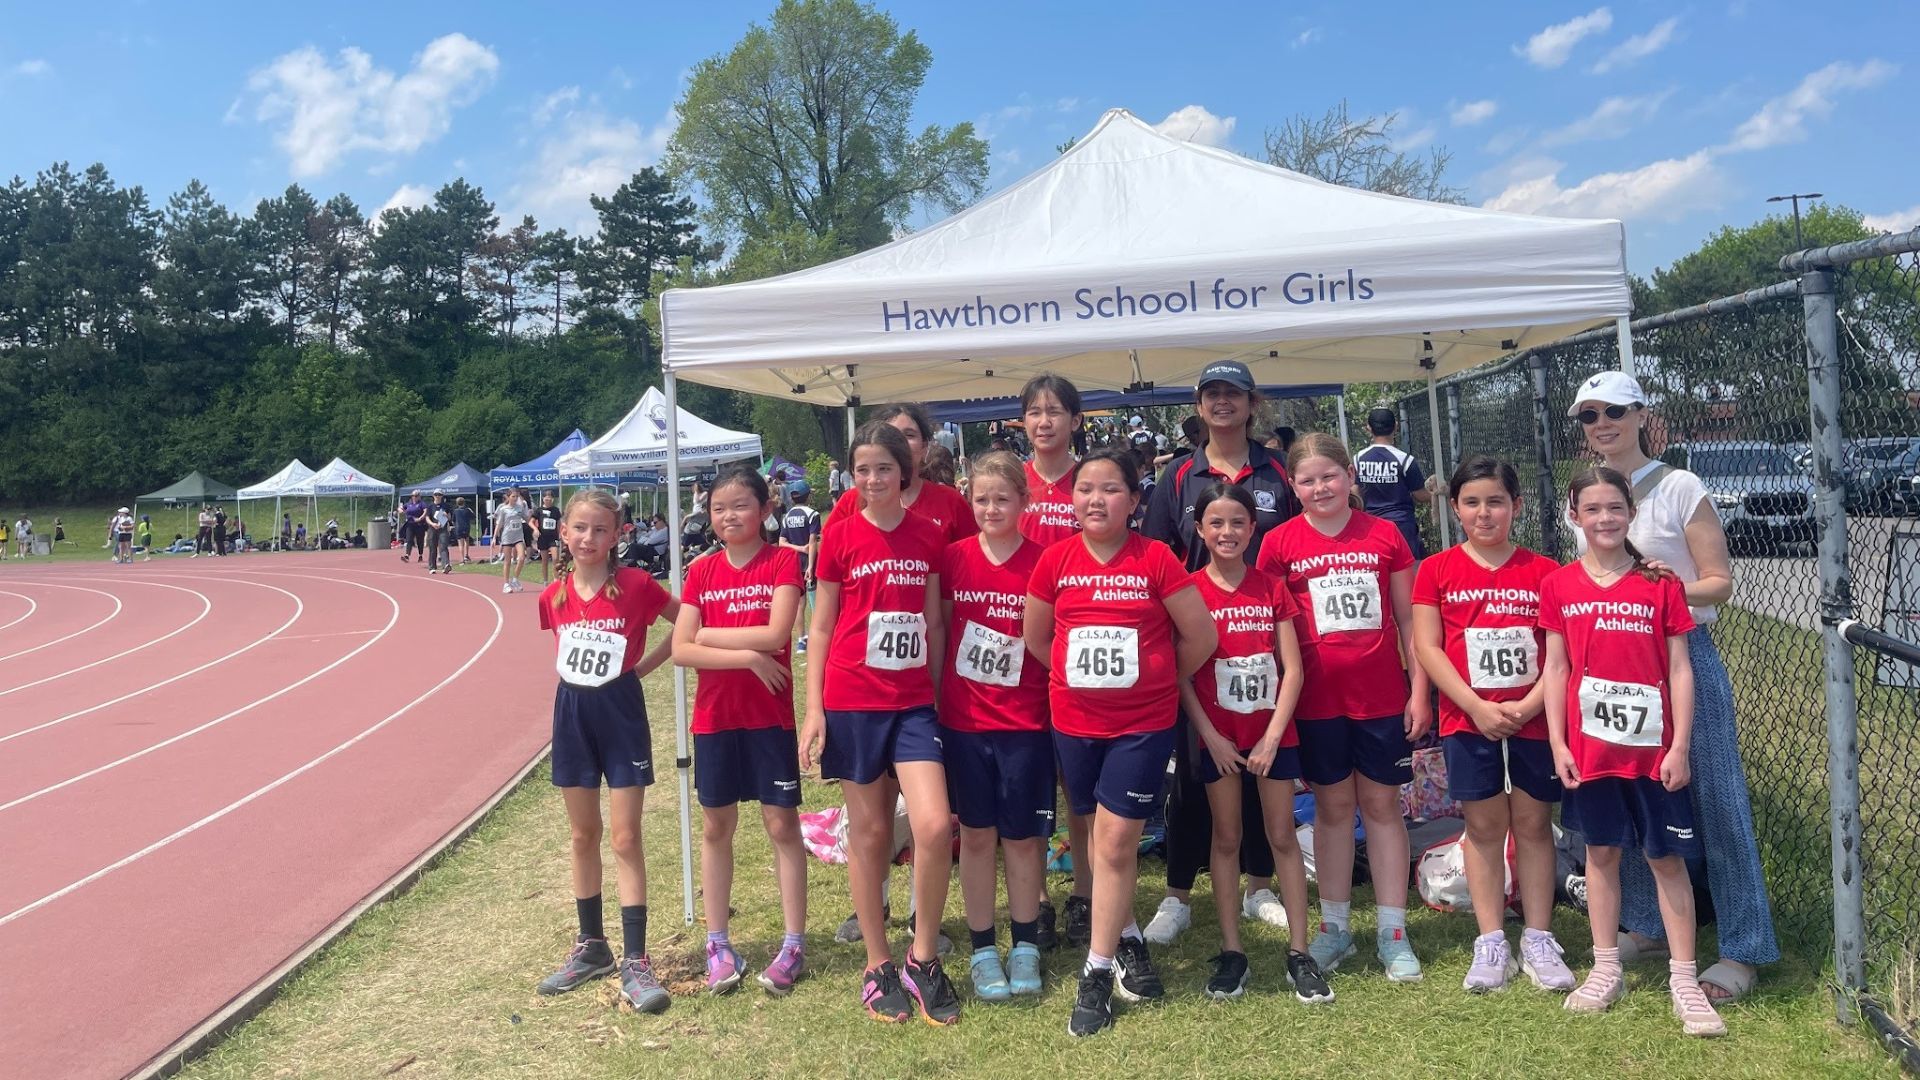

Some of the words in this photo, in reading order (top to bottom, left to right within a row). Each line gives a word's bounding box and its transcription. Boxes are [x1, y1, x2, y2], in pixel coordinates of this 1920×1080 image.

[882, 294, 1061, 333] Hawthorn
[1073, 280, 1198, 322] School
[1211, 277, 1267, 311] for
[1282, 268, 1376, 305] Girls
[611, 442, 741, 461] www.villanacollege.org
[1359, 461, 1399, 477] PUMAS
[493, 474, 521, 484] ROYAL
[1040, 514, 1081, 529] Athletic
[852, 559, 930, 579] HAWTHORN
[1291, 552, 1379, 573] HAWTHORN
[1059, 575, 1148, 588] HAWTHORN
[1320, 576, 1369, 589] C.I.S.A.A.
[699, 584, 774, 604] HAWTHORN
[953, 590, 1027, 607] HAWTHOR
[1092, 589, 1149, 601] Athletics
[1446, 588, 1540, 603] HAWTHORN
[986, 605, 1024, 620] Athleti
[1210, 606, 1273, 621] WTHORN
[1325, 592, 1373, 621] 462
[1485, 602, 1540, 617] Athletics
[1561, 601, 1655, 619] HAWTHORN
[1227, 620, 1274, 633] Athletics
[1595, 617, 1654, 635] Athletics
[571, 630, 616, 645] C.I.S.A.A.
[974, 627, 1014, 647] C.I.S.A.A.
[1077, 630, 1126, 641] C.I.S.A.A.
[1476, 630, 1526, 641] C.I.S.A.A.
[879, 631, 921, 659] 460
[566, 647, 611, 677] 468
[967, 644, 1011, 678] 464
[1077, 648, 1125, 676] 465
[1480, 647, 1528, 677] 463
[1229, 674, 1268, 702] 461
[1592, 682, 1650, 698] C.I.S.A.A.
[1594, 701, 1648, 735] 457
